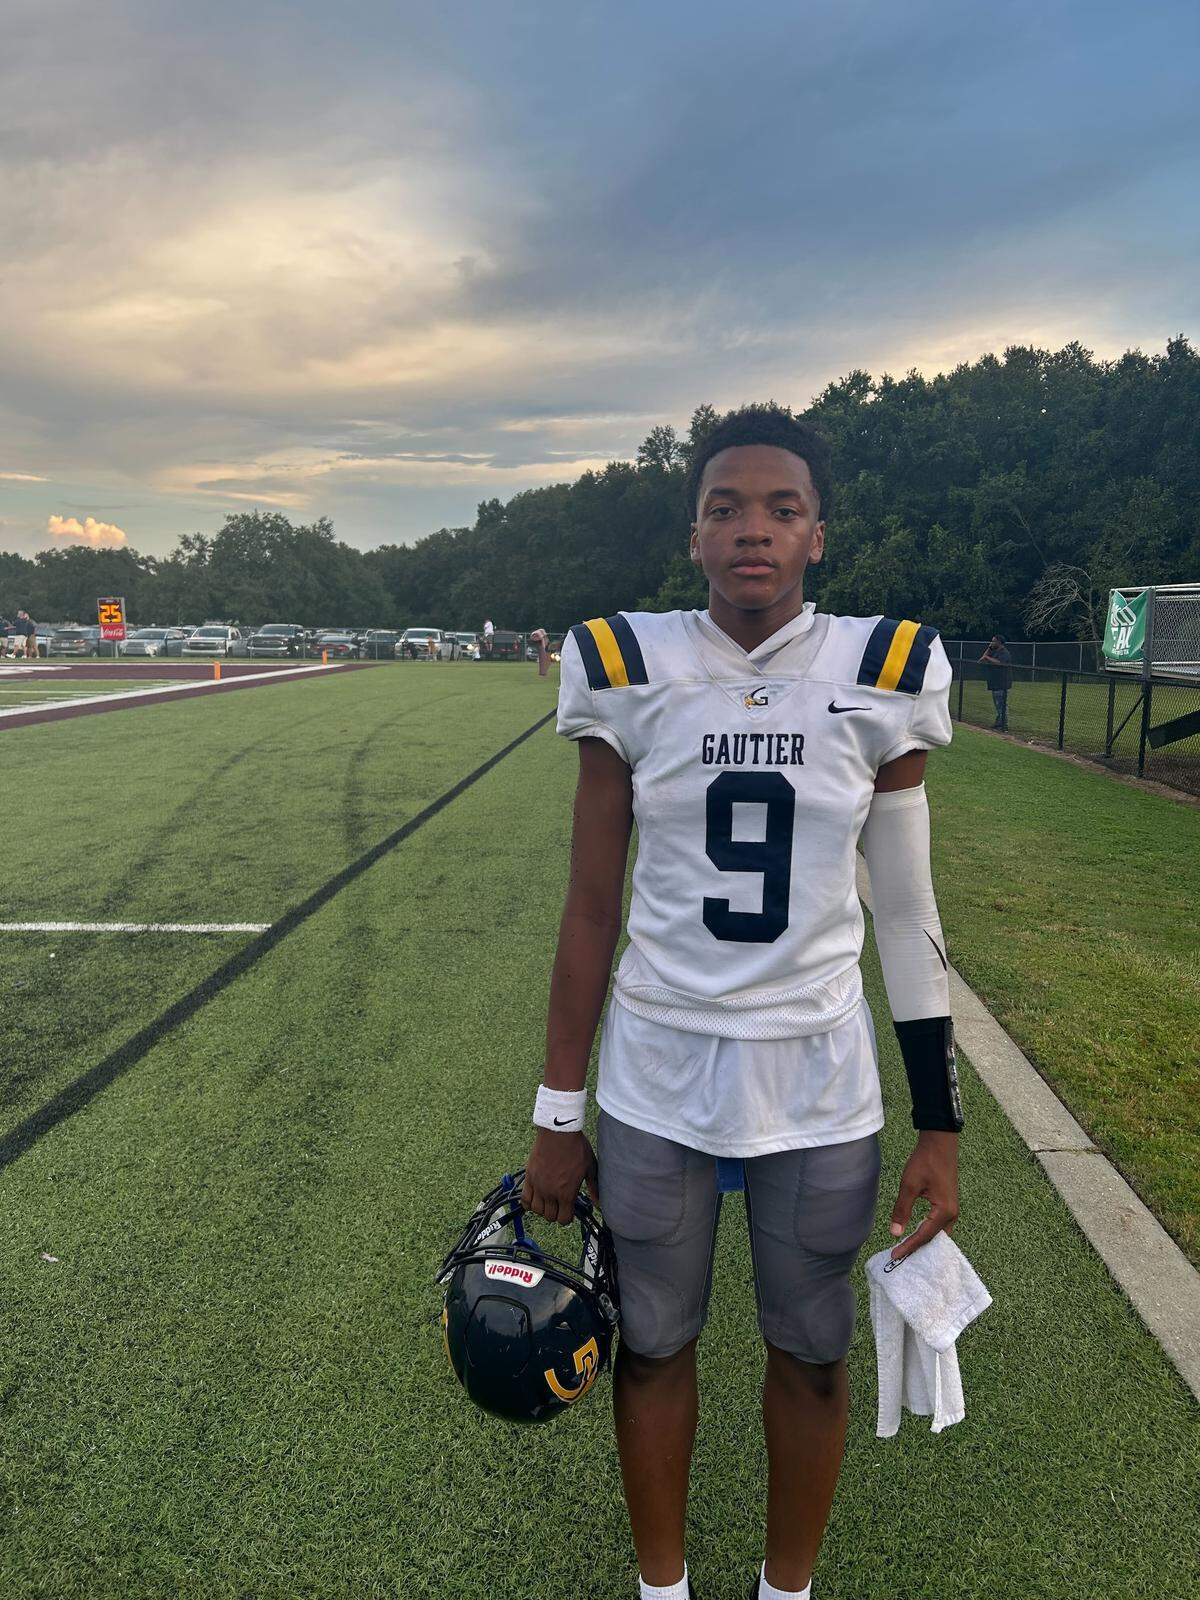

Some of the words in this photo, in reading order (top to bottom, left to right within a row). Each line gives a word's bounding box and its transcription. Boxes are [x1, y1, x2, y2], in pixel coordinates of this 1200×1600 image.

[100, 604, 122, 623] 25
[702, 733, 805, 765] GAUTIER
[702, 771, 796, 944] 9
[487, 1263, 533, 1284] Riddell
